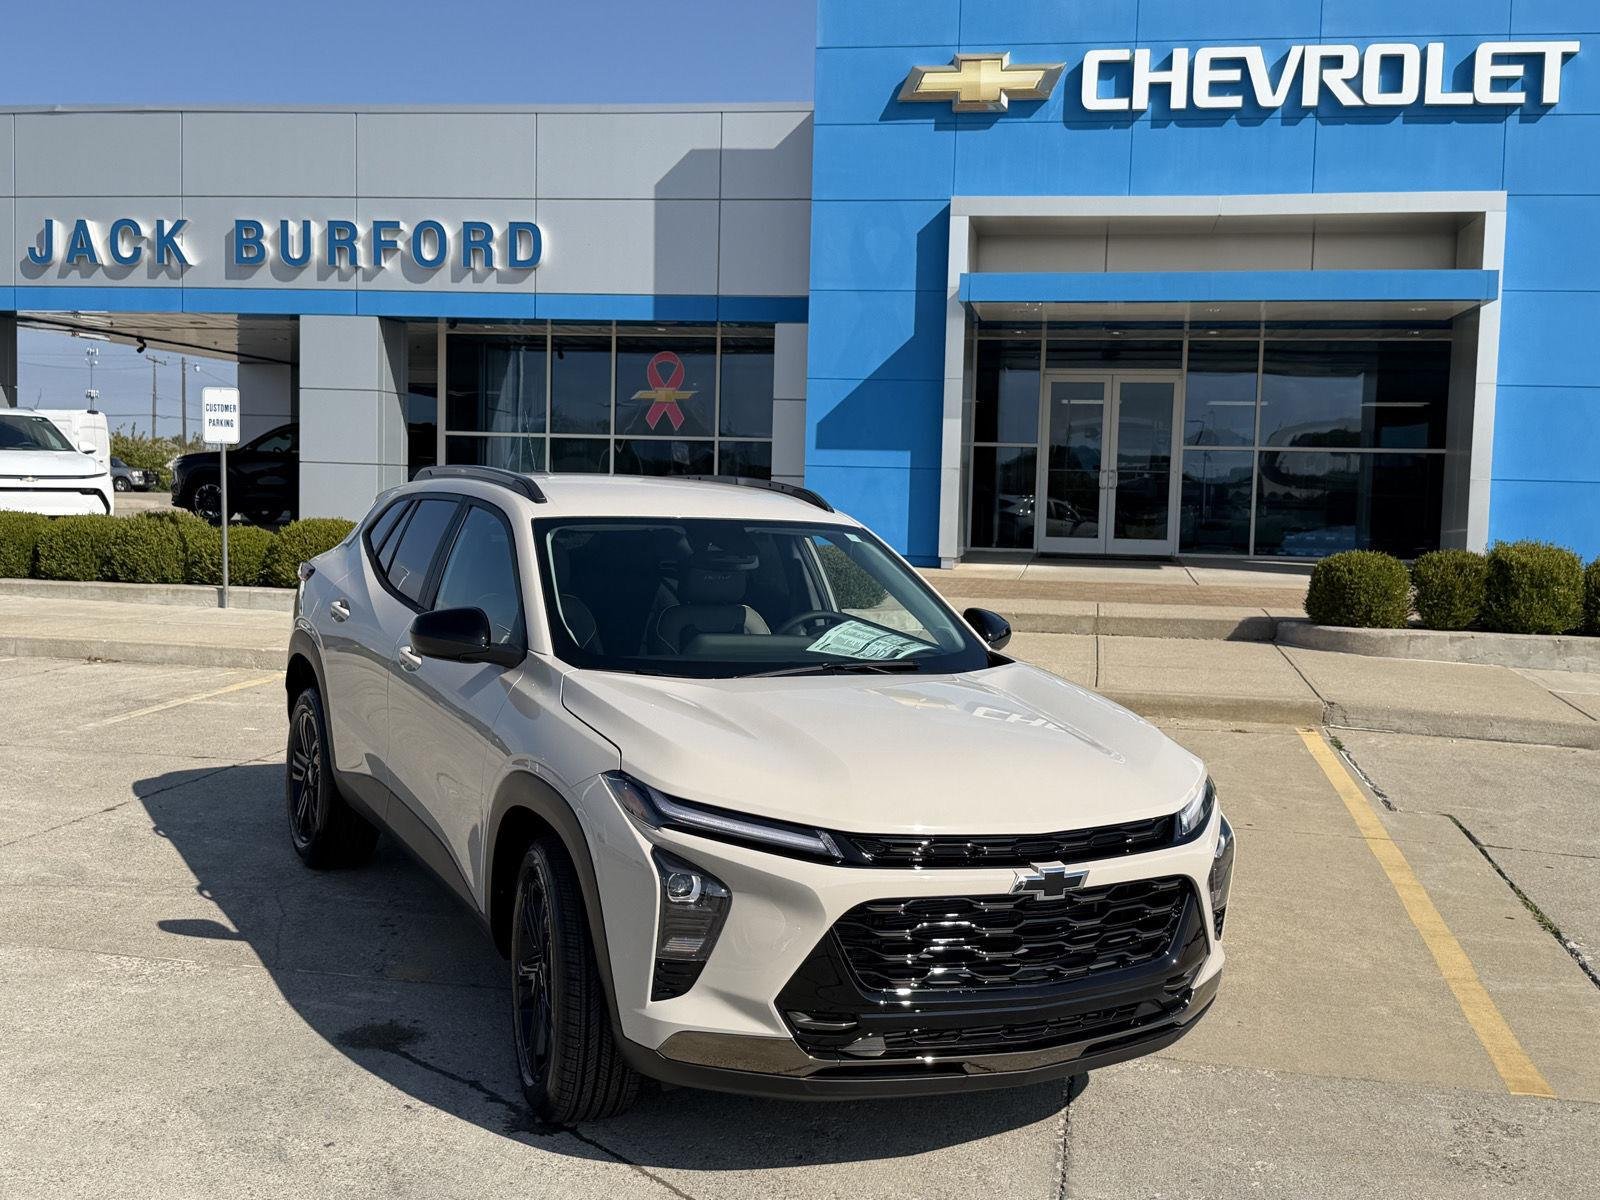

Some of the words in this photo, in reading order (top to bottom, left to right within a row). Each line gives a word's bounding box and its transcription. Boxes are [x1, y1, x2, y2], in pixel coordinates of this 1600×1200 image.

[1081, 40, 1581, 111] CHEVROLET
[28, 218, 190, 266] JACK
[234, 219, 543, 269] BURFORD
[205, 403, 237, 413] CUSTOMER
[208, 418, 234, 428] PARKING
